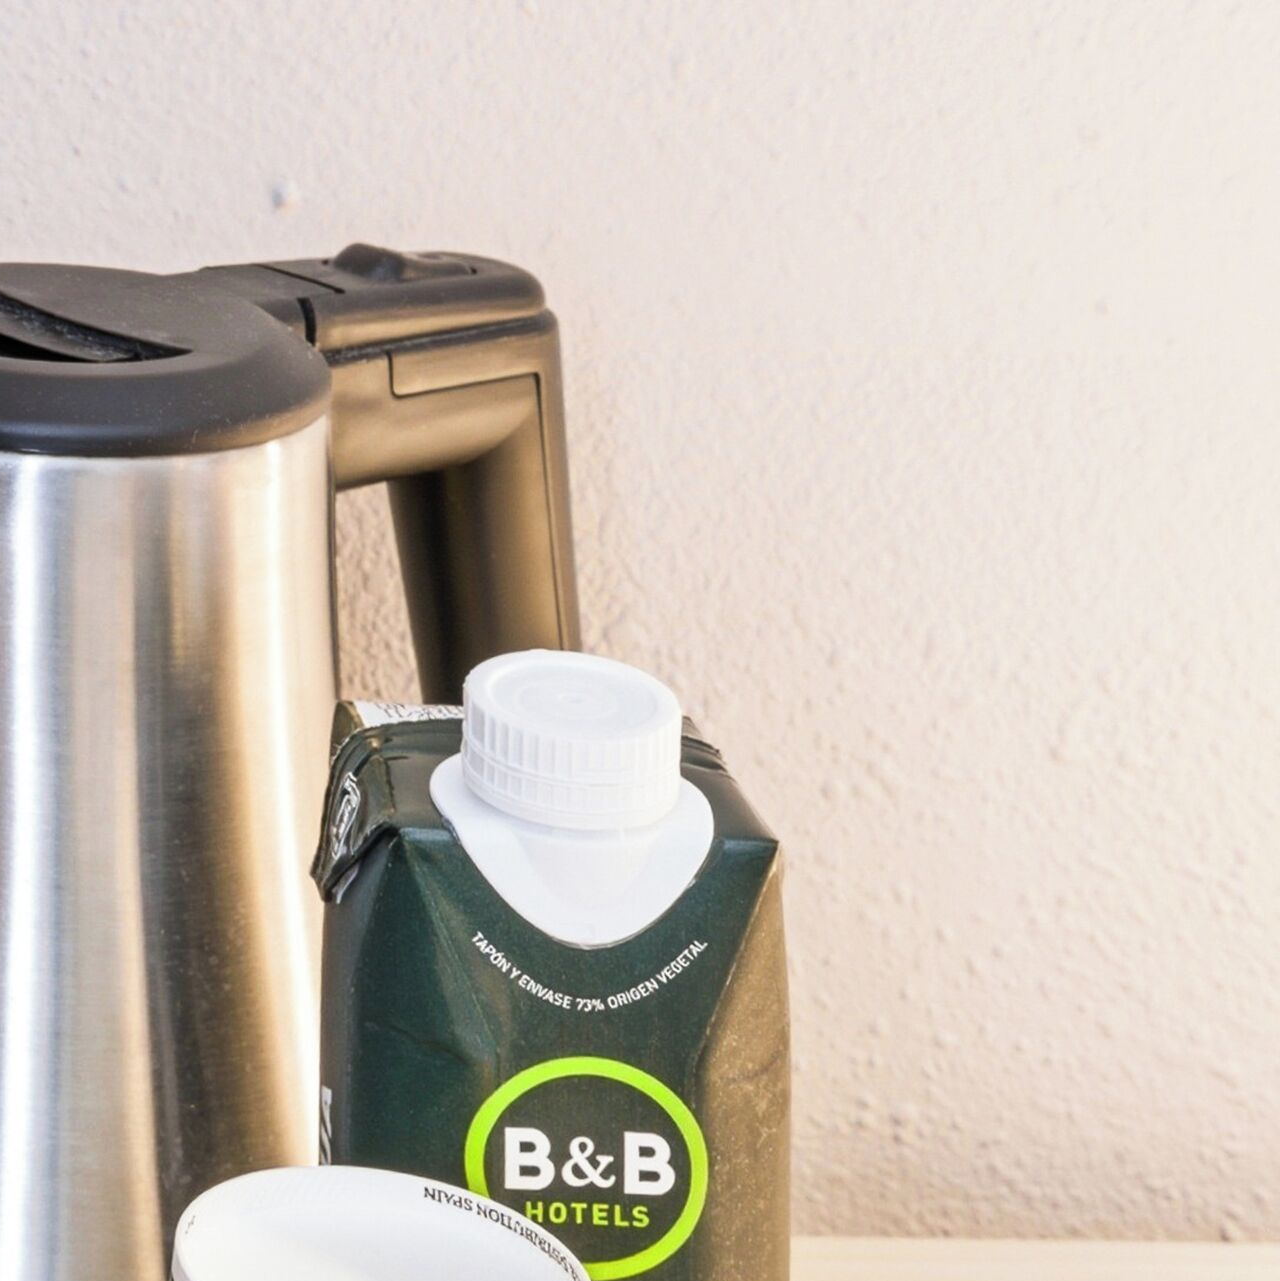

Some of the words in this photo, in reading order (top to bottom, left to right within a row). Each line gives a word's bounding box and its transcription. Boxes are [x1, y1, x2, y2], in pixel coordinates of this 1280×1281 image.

[471, 931, 512, 973] TAPÓN
[509, 966, 522, 980] Y
[518, 974, 573, 1010] ENVASE
[575, 998, 606, 1012] 73%
[607, 978, 659, 1010] ORIGEN
[656, 938, 709, 984] VEGETAL
[503, 1127, 676, 1196] B&B
[424, 1186, 473, 1212] SPAIN
[524, 1201, 651, 1229] HOTELS
